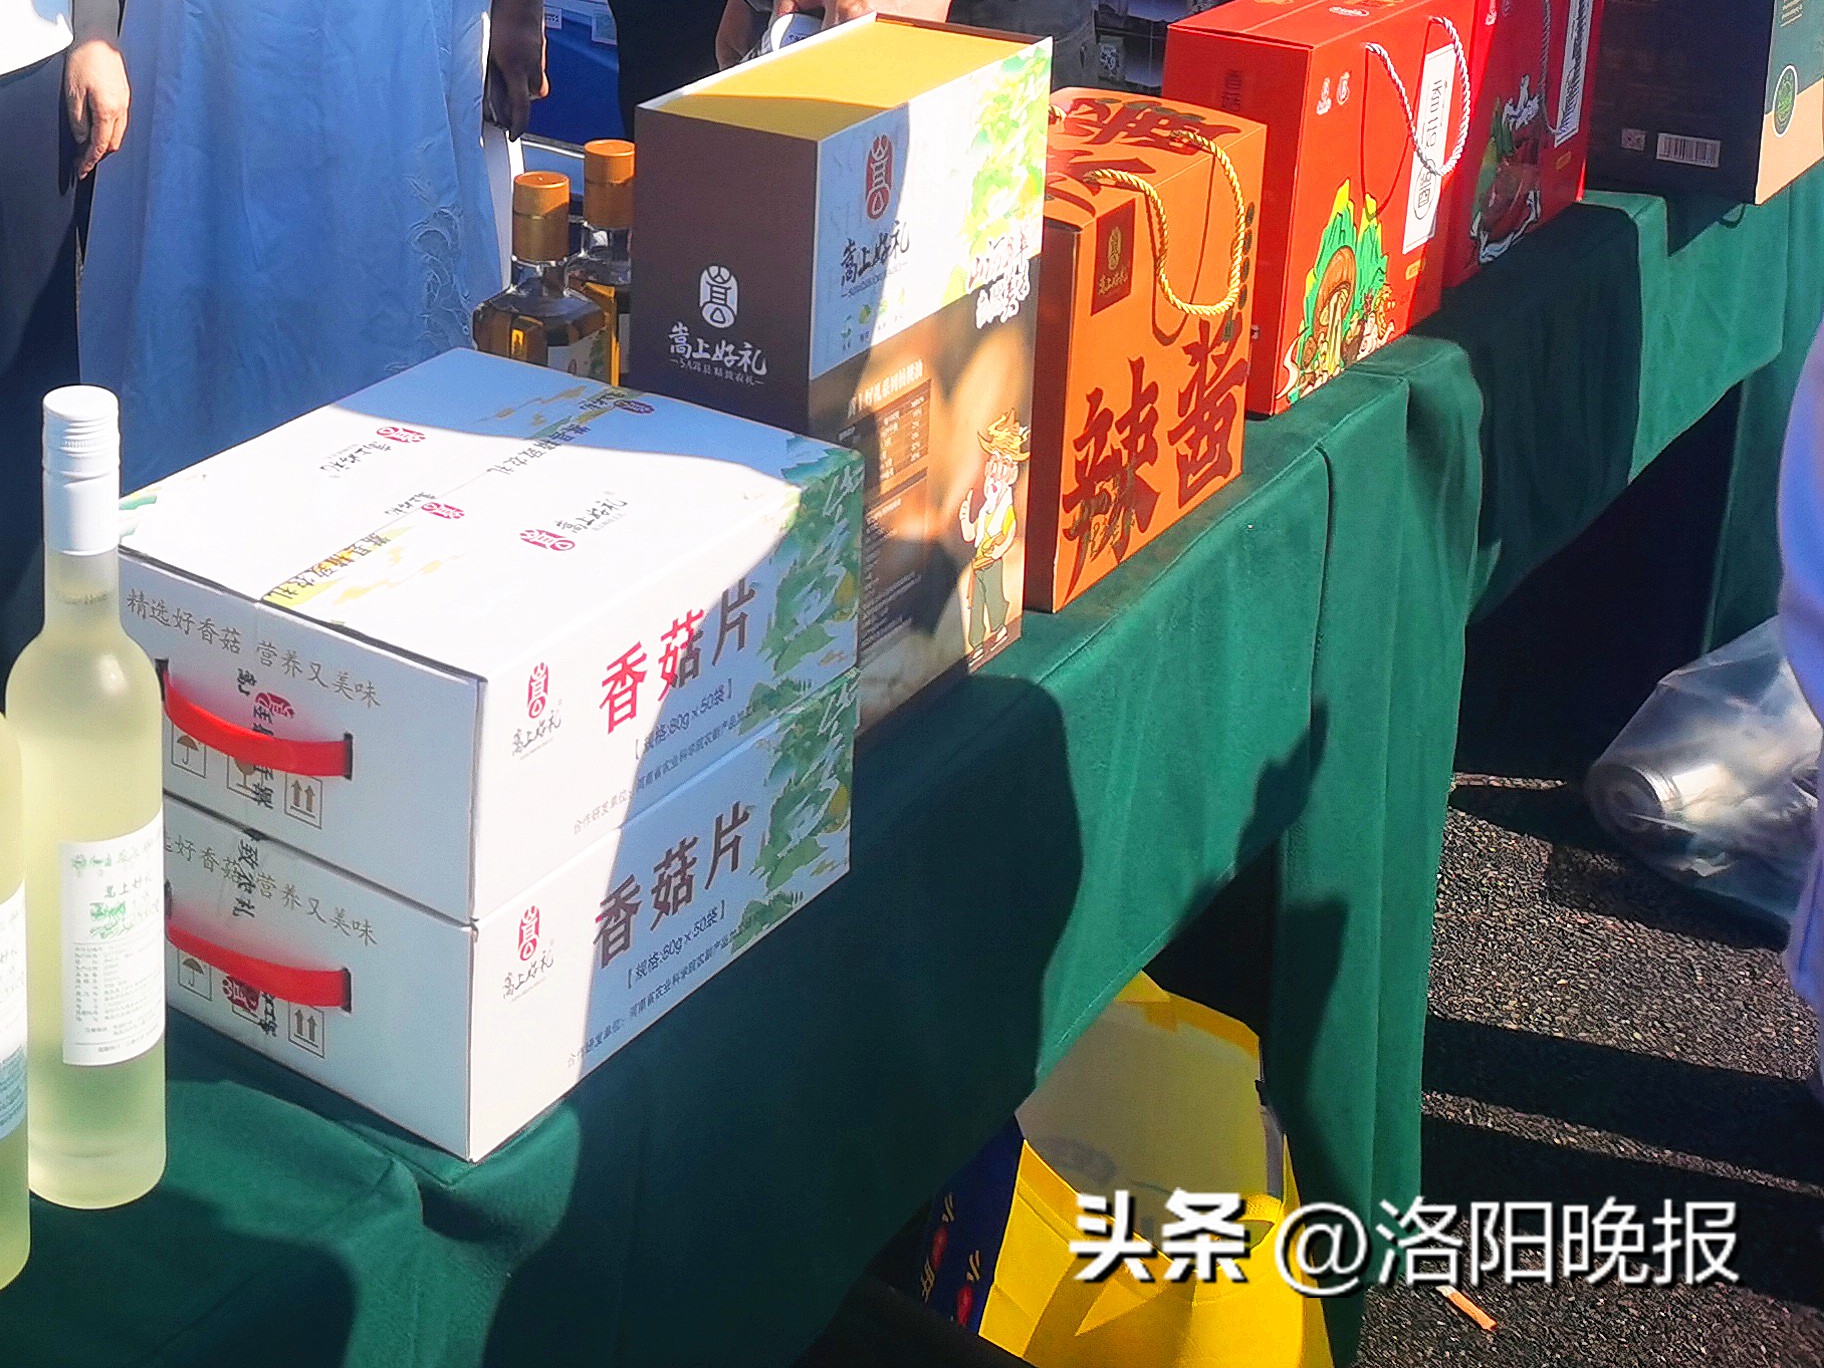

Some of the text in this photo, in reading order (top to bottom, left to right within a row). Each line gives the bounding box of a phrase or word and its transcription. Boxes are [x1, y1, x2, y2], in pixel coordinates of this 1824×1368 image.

[668, 321, 768, 376] 嵩上好礼
[126, 588, 241, 655] 精选好香菇
[256, 640, 382, 708] 营养又美味
[599, 577, 758, 735] 香菇片
[593, 800, 750, 970] 香菇片
